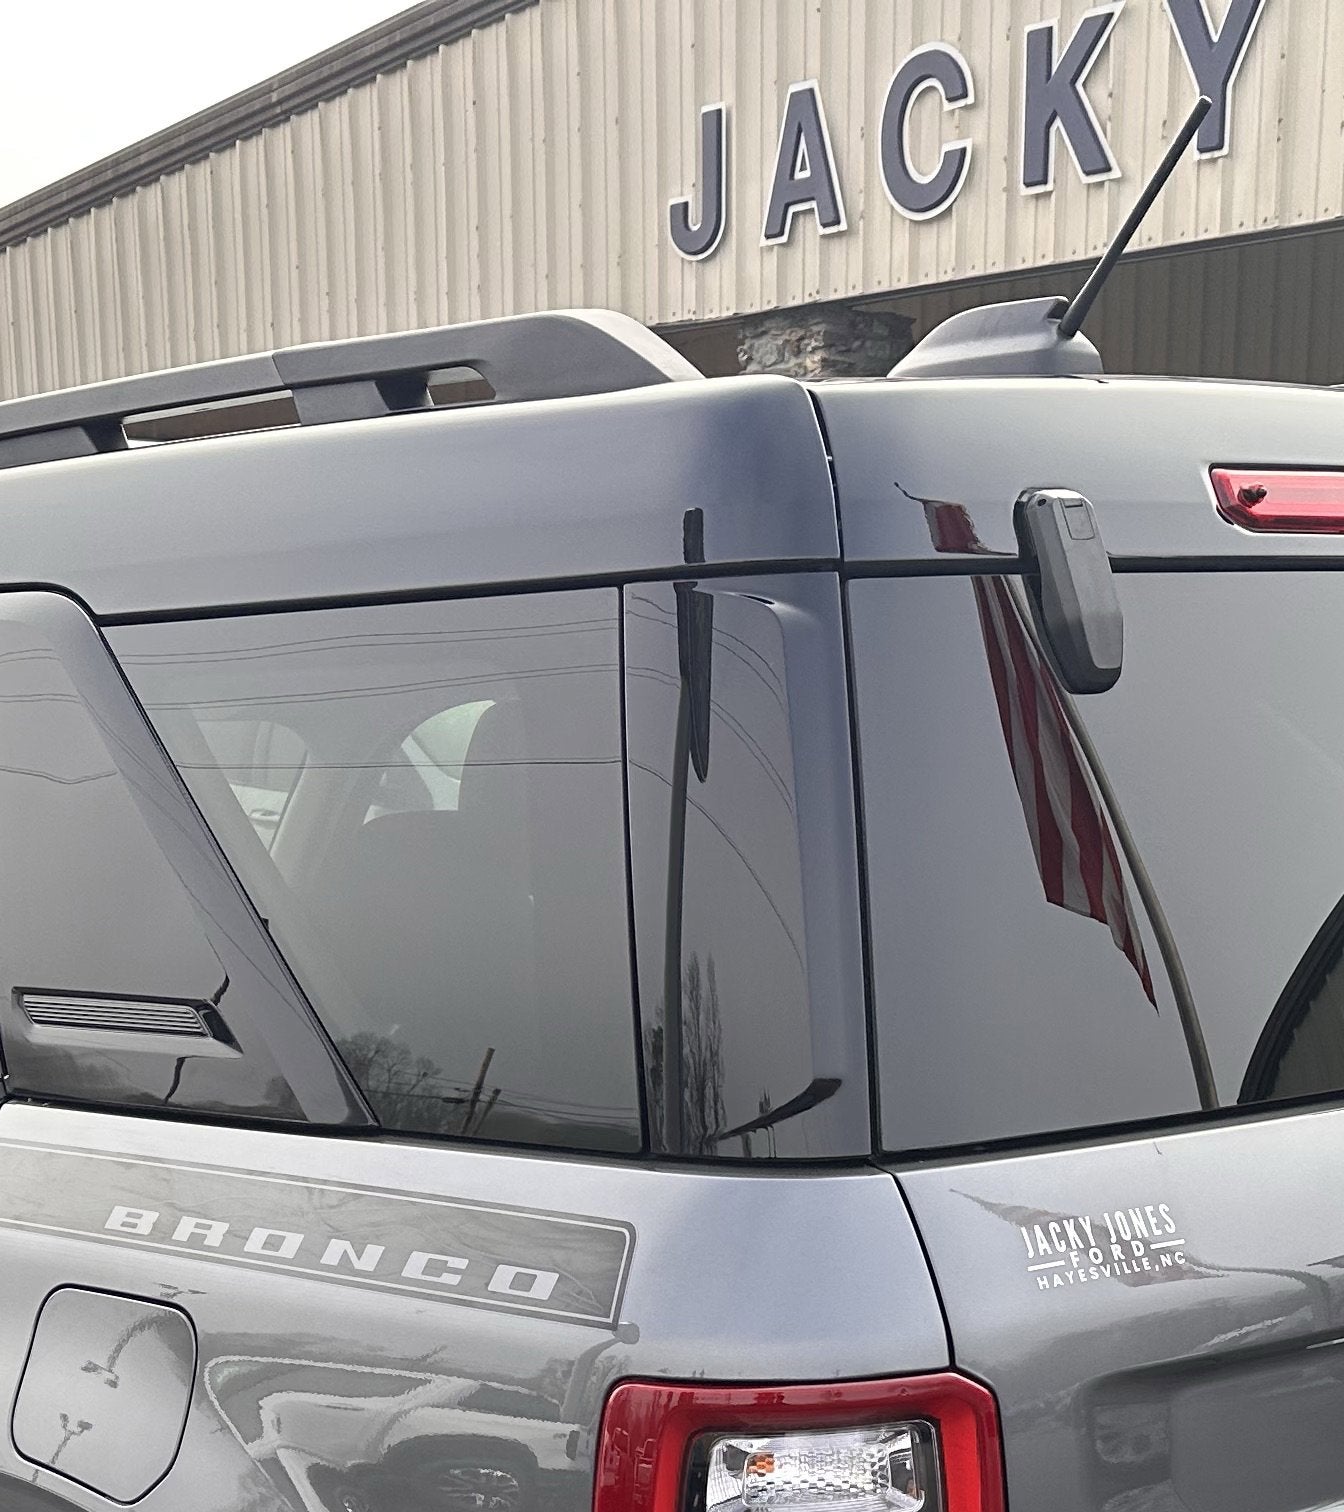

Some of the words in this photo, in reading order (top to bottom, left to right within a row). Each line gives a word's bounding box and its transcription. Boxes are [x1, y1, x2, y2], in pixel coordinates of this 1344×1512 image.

[669, 0, 1262, 261] JACKY
[104, 1205, 559, 1300] BRONCO
[1020, 1215, 1096, 1259] JACKY
[1103, 1203, 1177, 1244] JONES
[1069, 1240, 1145, 1269] FORD
